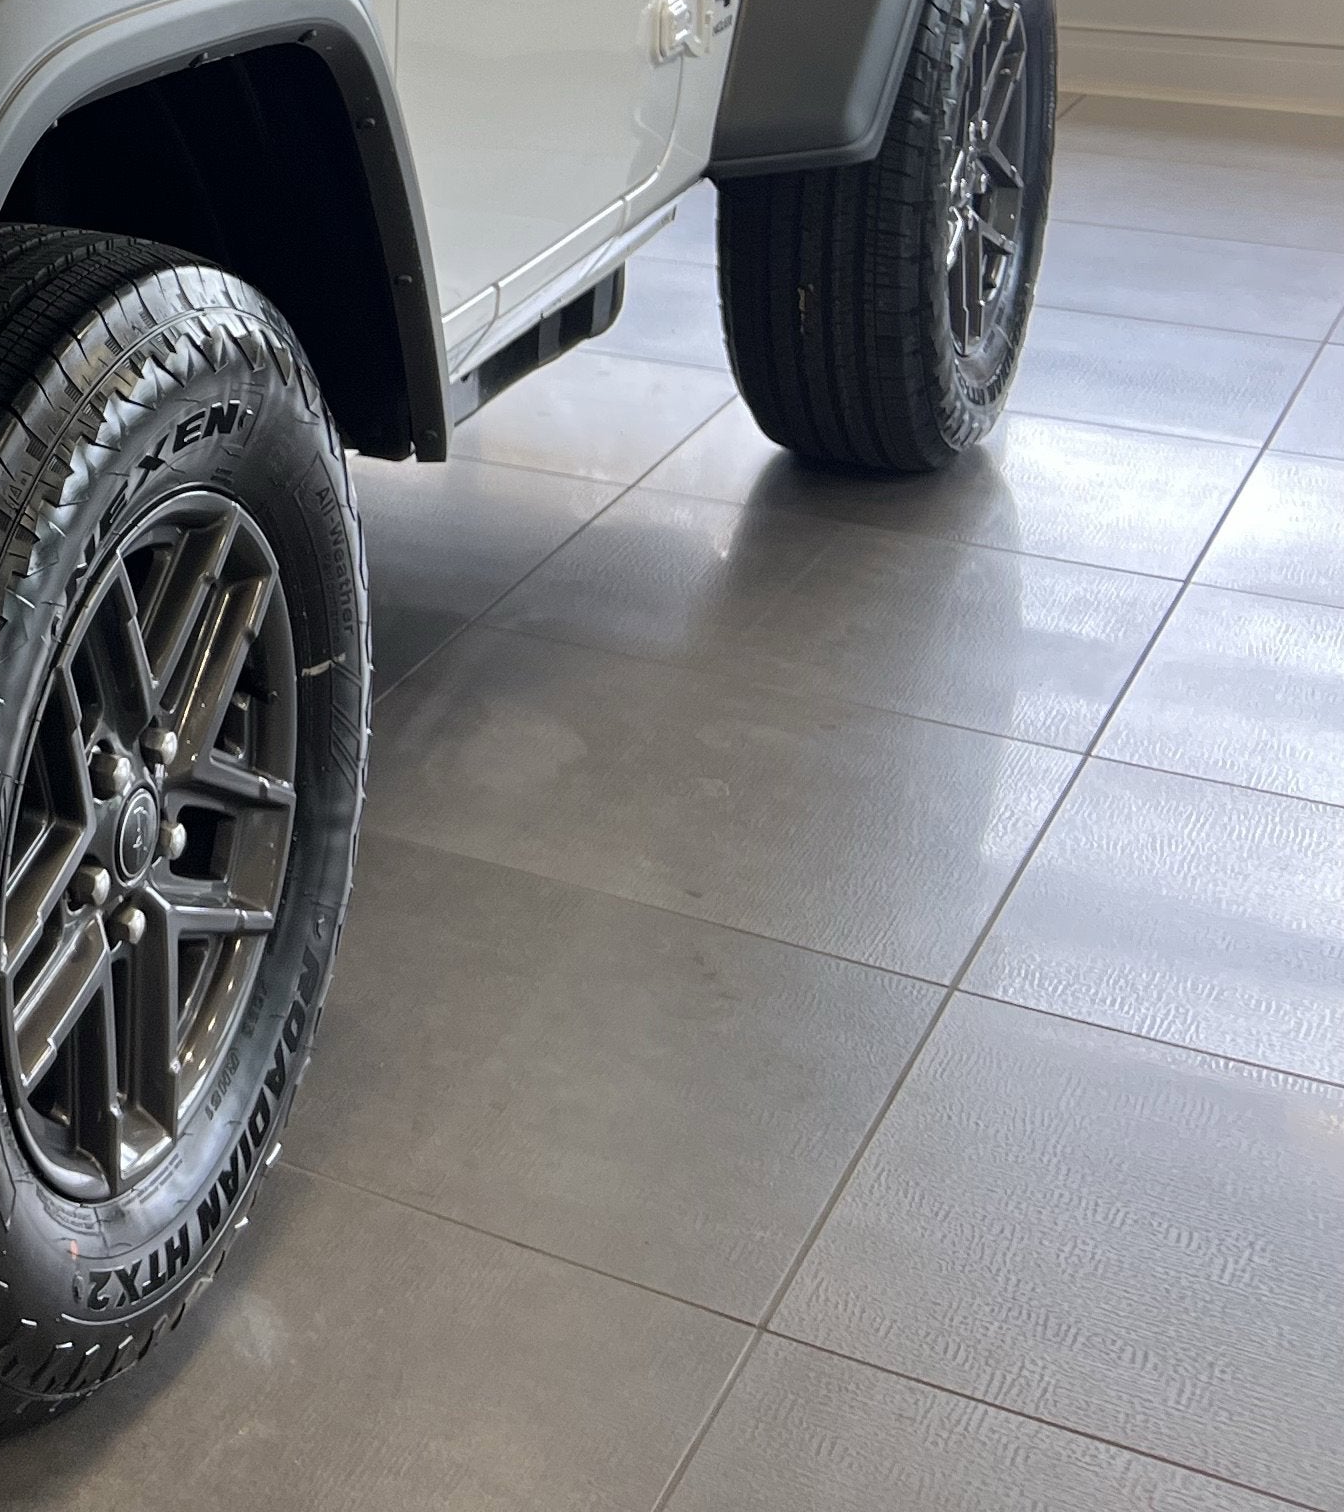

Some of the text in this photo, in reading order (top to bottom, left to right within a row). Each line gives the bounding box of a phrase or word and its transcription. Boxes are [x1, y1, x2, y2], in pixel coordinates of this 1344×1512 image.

[64, 399, 241, 612] NEXEN
[315, 486, 355, 636] All-Weather
[86, 945, 321, 1311] ROADIAN HTX2
